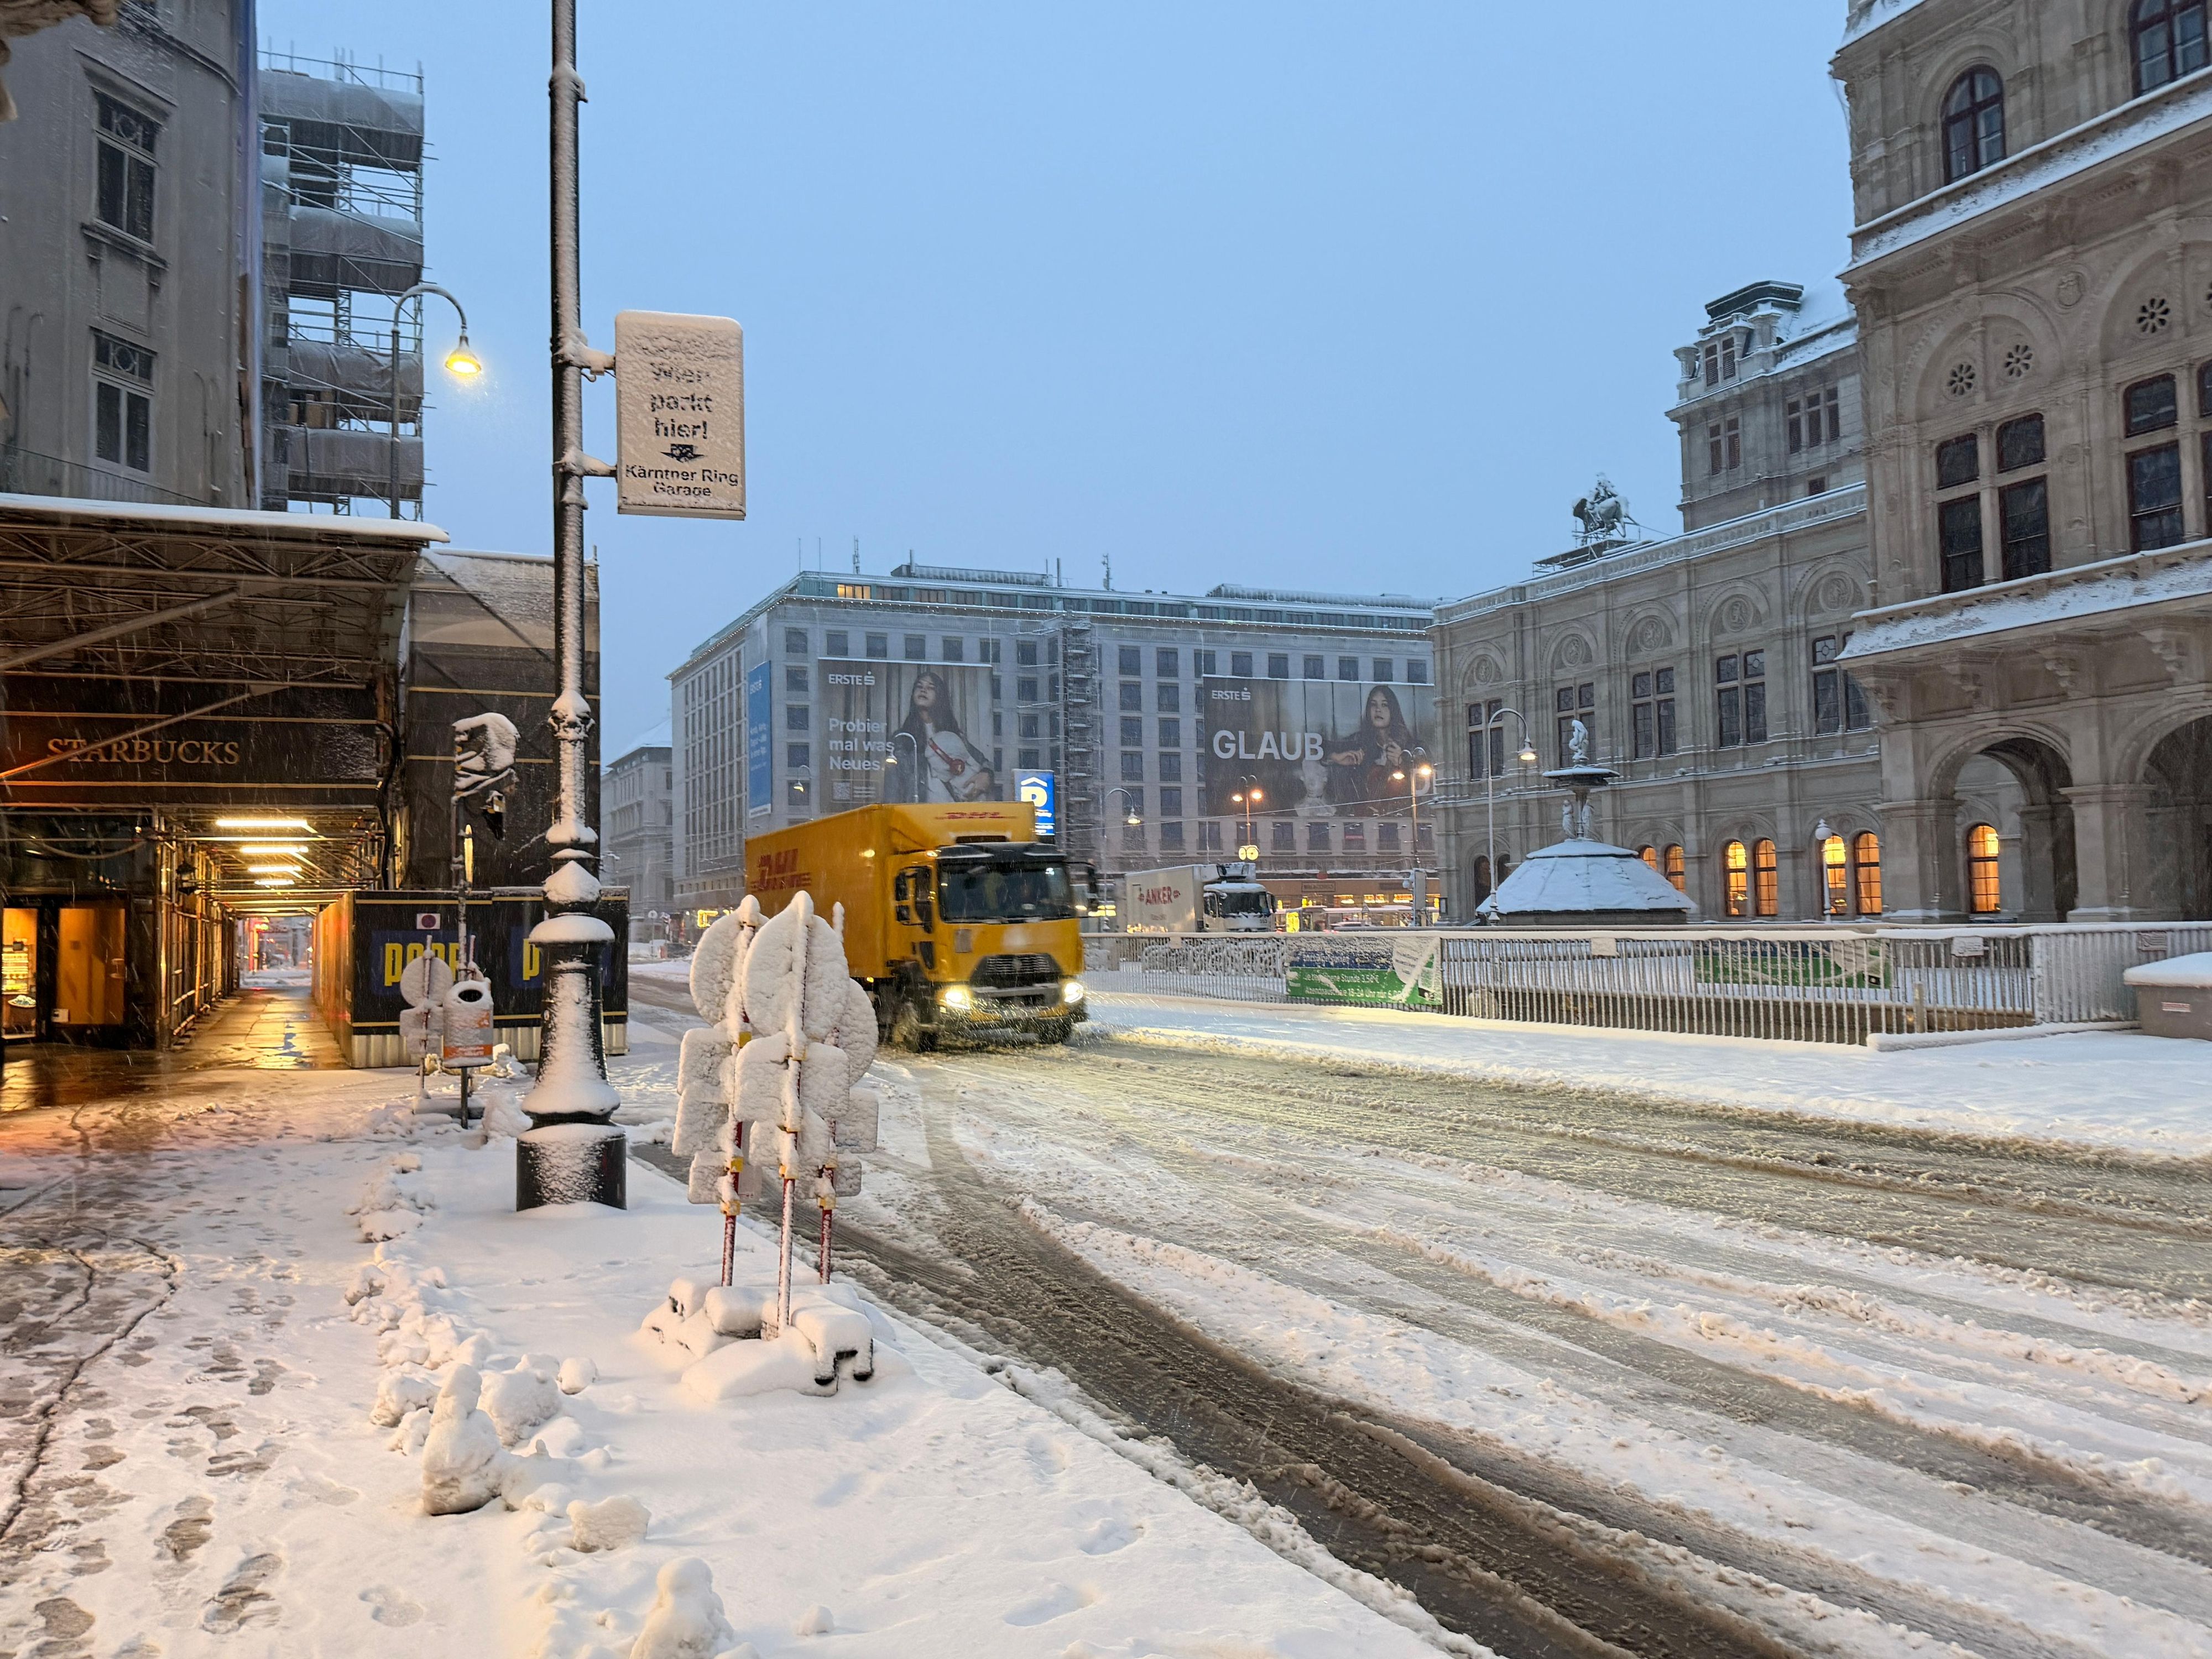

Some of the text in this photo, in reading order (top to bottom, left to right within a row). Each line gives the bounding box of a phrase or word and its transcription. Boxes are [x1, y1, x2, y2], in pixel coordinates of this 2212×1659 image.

[651, 393, 712, 413] parkt
[655, 417, 707, 439] hier!
[626, 465, 738, 486] Kärntner Ring
[654, 482, 712, 497] Garage
[829, 674, 863, 685] ERSTE
[1212, 690, 1240, 700] ERSTE
[830, 718, 888, 733] Probier
[47, 738, 239, 765] STARBUCKS
[830, 738, 895, 753] mal was
[1213, 729, 1324, 761] GLAUB
[830, 756, 885, 771] Neues.
[1146, 886, 1172, 904] ANKER
